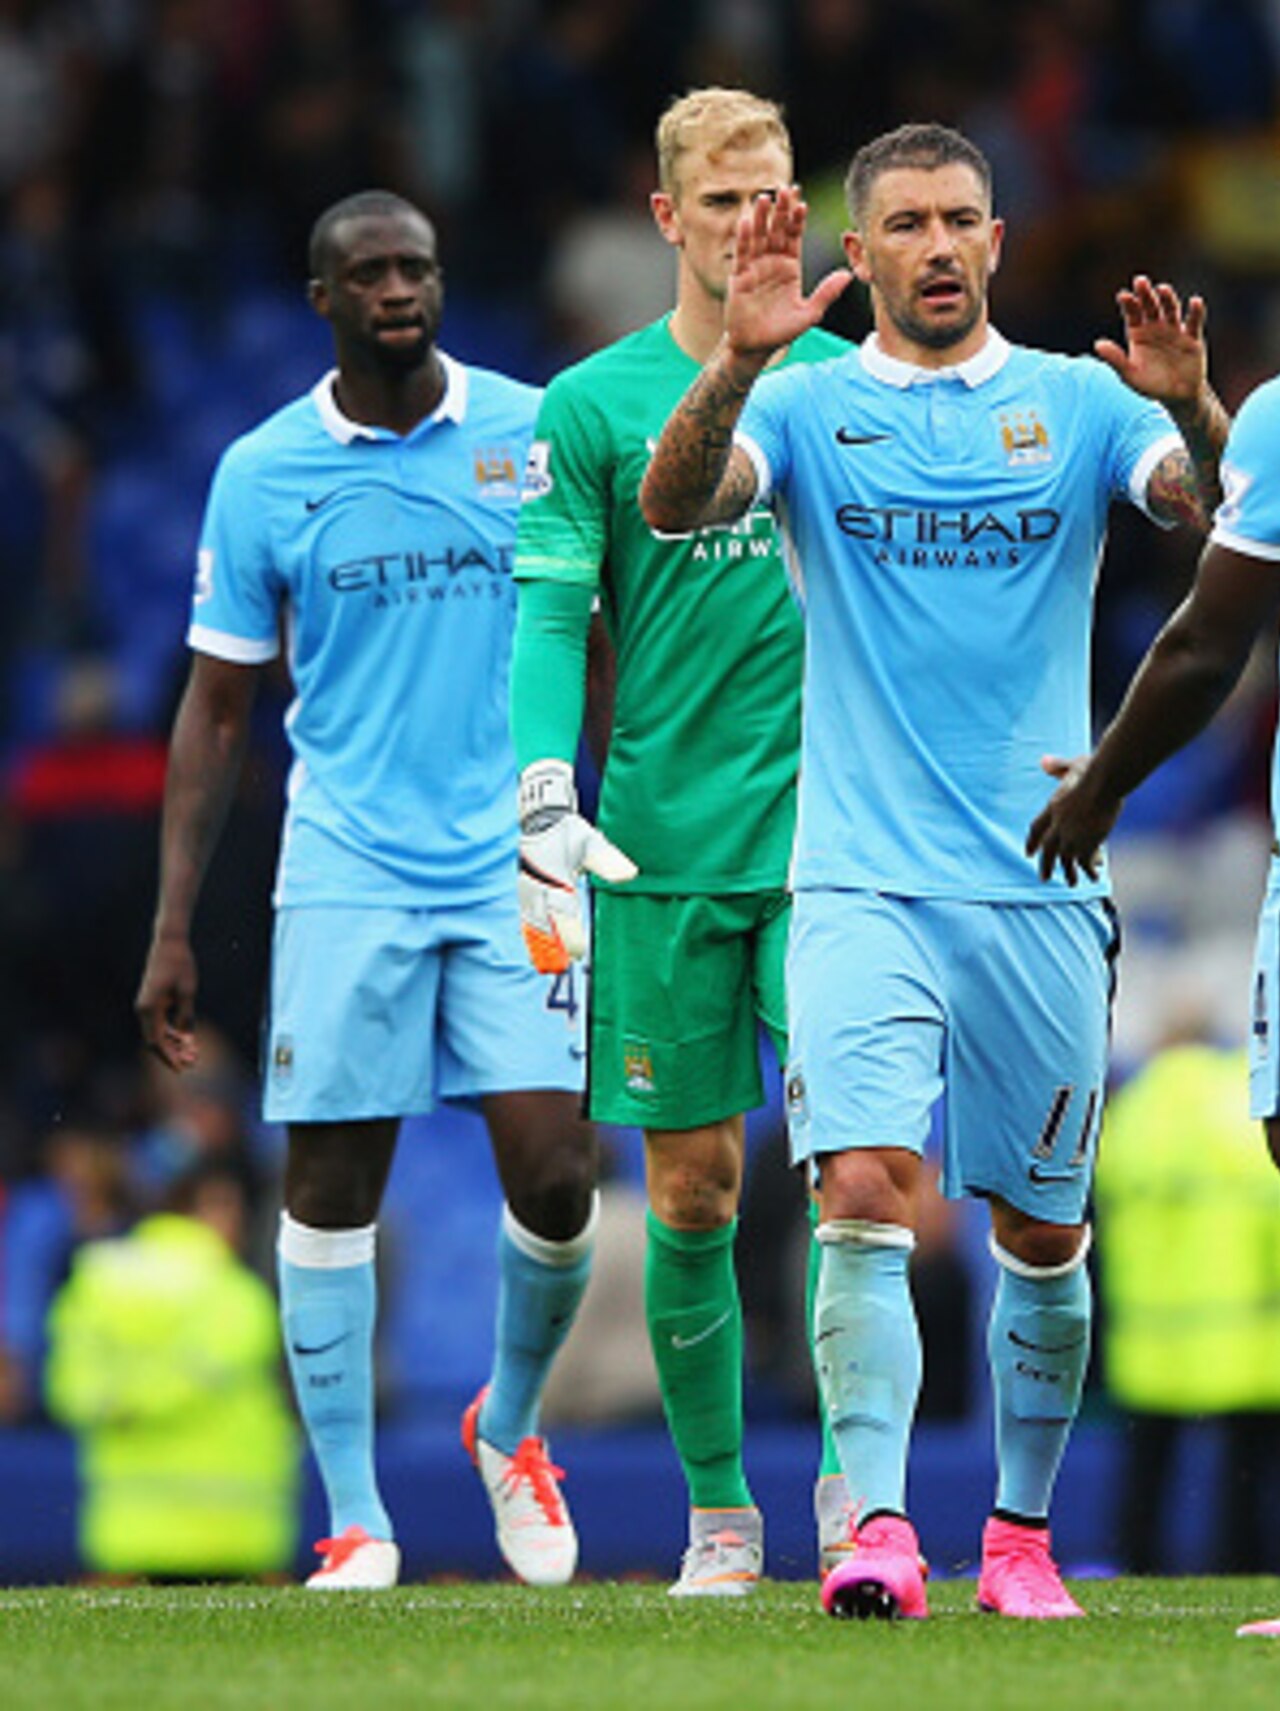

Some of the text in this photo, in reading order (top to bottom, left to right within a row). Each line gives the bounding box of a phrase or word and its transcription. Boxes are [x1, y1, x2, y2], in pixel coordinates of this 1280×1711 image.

[834, 503, 1061, 544] ETIHAD
[692, 539, 781, 561] AIRW
[874, 549, 1021, 569] AIRWAYS
[373, 582, 503, 609] AIRWAYS
[543, 962, 591, 1033] 4
[1031, 1084, 1098, 1167] 11
